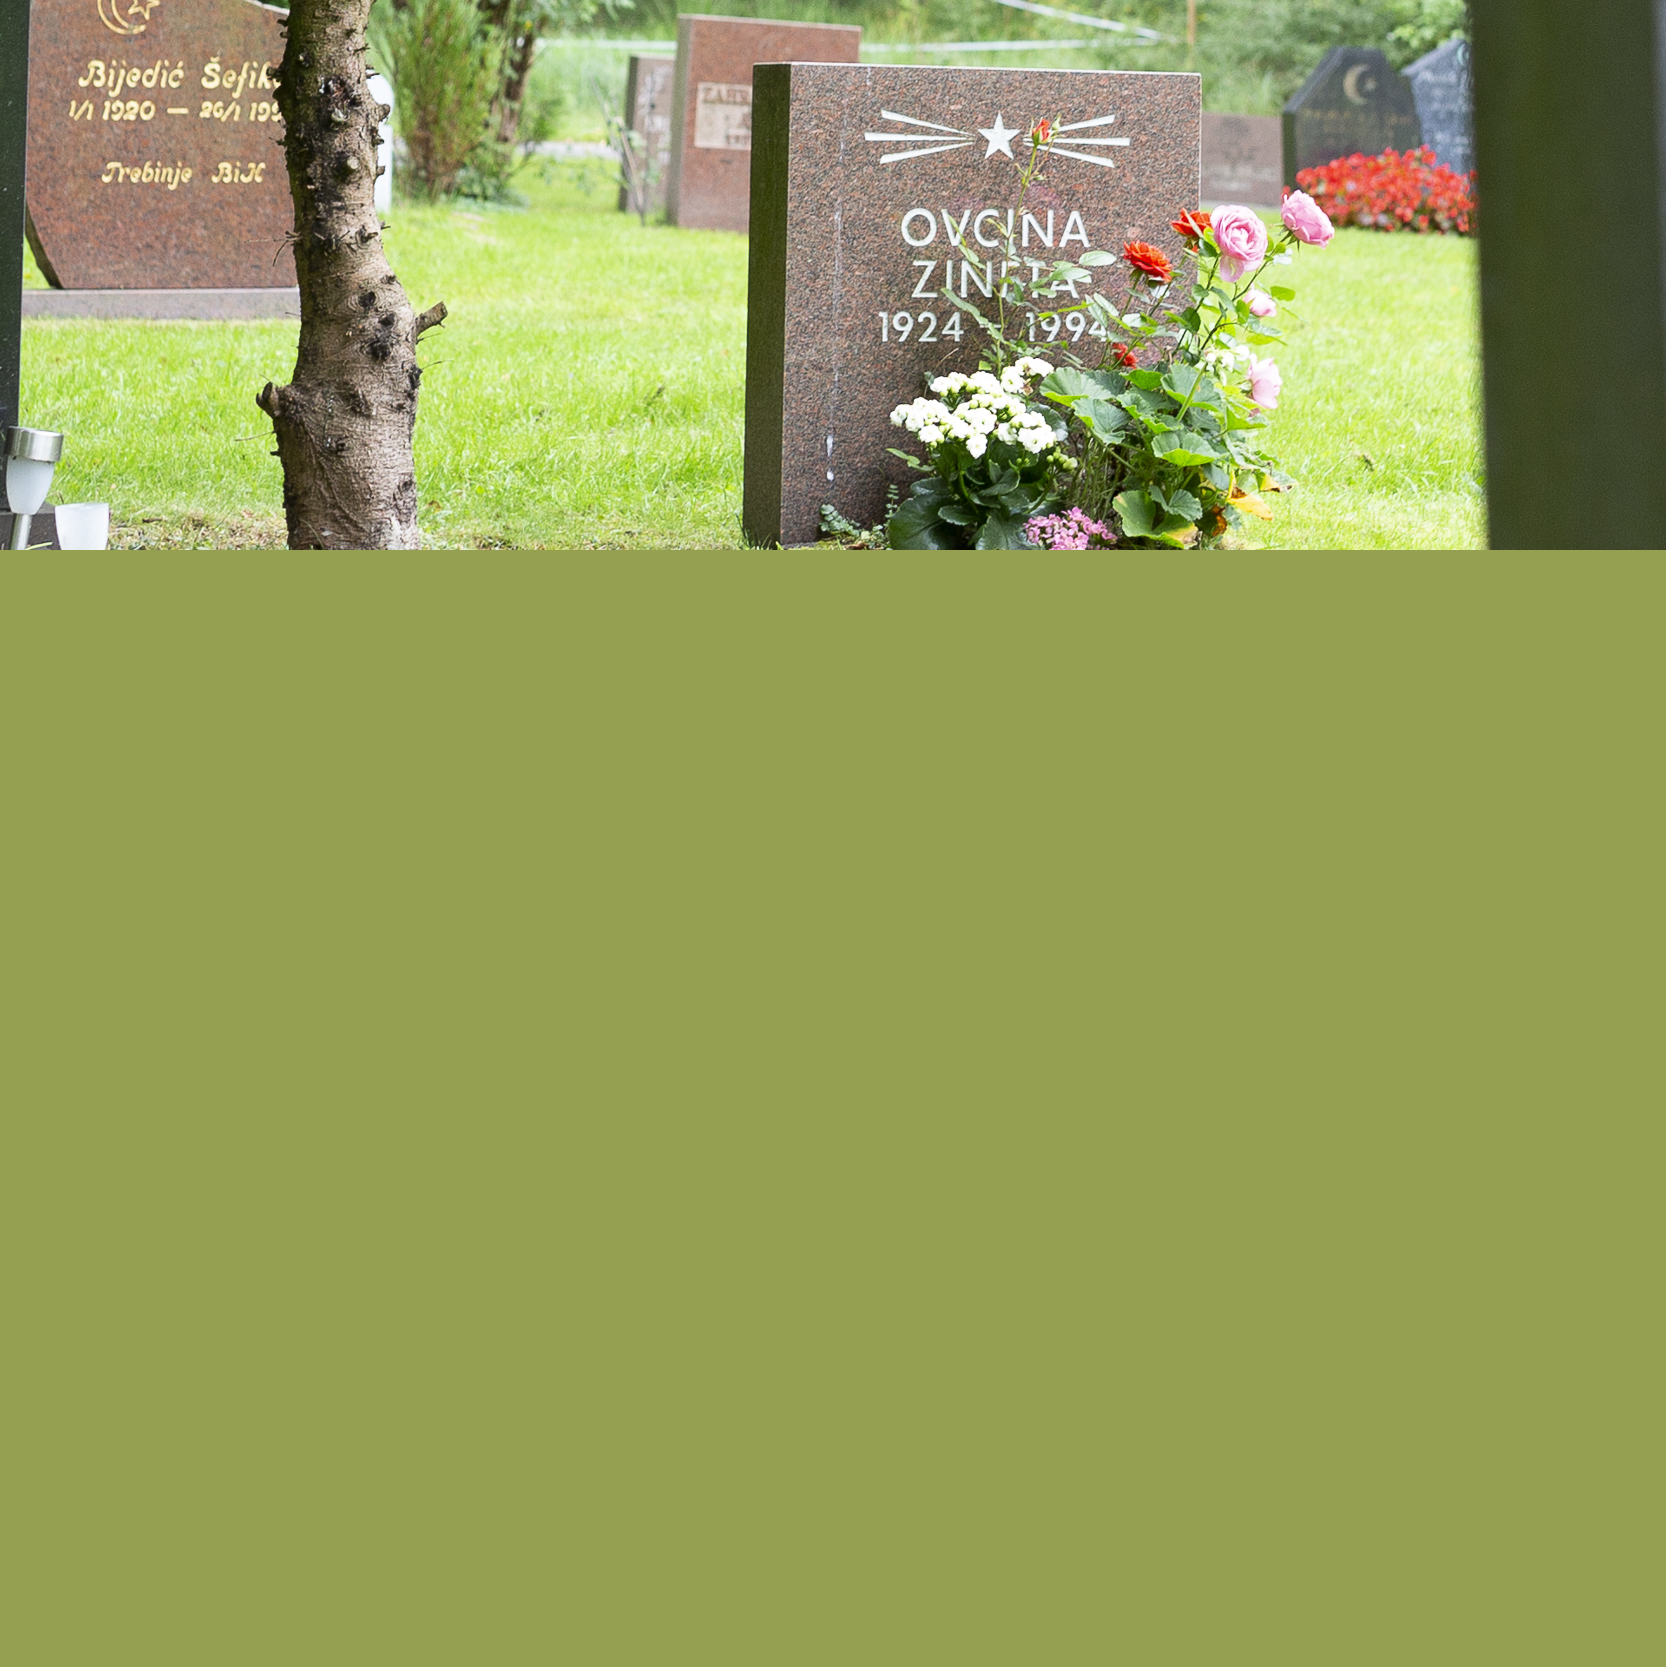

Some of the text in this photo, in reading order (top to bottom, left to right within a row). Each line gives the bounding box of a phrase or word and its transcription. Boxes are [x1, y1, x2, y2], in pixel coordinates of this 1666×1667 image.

[78, 59, 185, 98] Bijedić
[102, 99, 156, 121] 1920
[101, 160, 193, 190] Trebinje
[901, 207, 1090, 248] OVCINA
[878, 310, 964, 342] 1924
[1024, 310, 1107, 342] 1994
